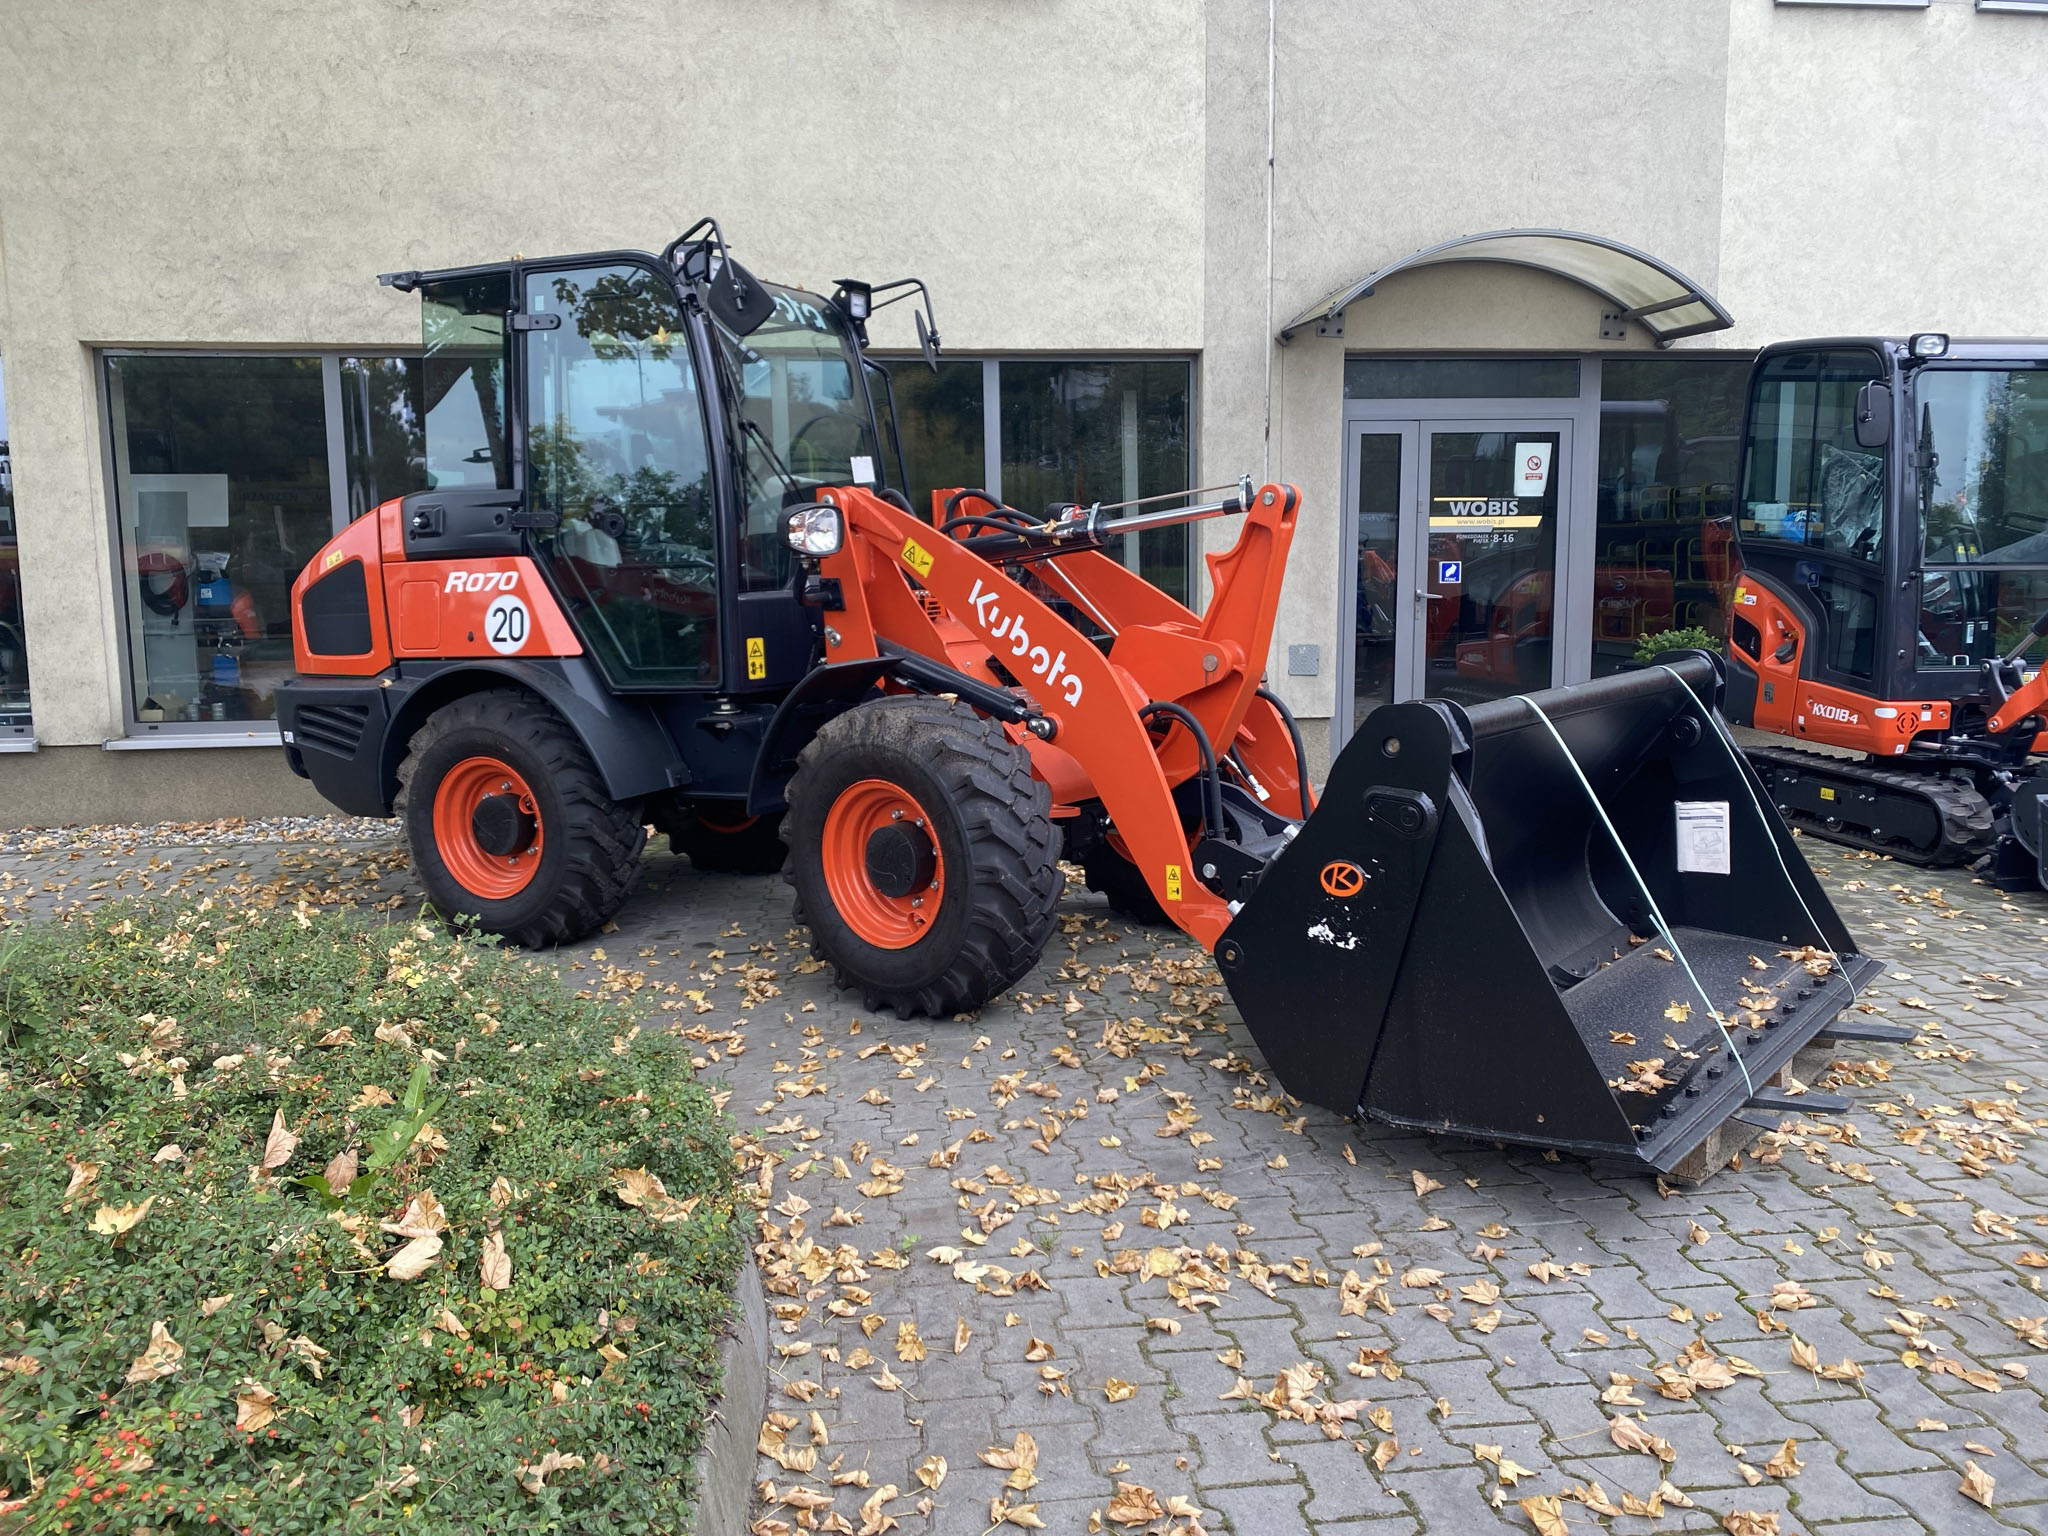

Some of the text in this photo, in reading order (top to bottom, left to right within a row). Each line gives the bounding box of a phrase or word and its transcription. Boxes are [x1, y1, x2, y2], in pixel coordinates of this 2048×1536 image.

[1449, 501, 1519, 516] WOBIS
[1456, 518, 1505, 526] www.wobis.pl
[444, 571, 519, 593] R070
[492, 606, 524, 642] 20
[968, 578, 1083, 708] Kubota
[1812, 703, 1859, 725] KX018-4
